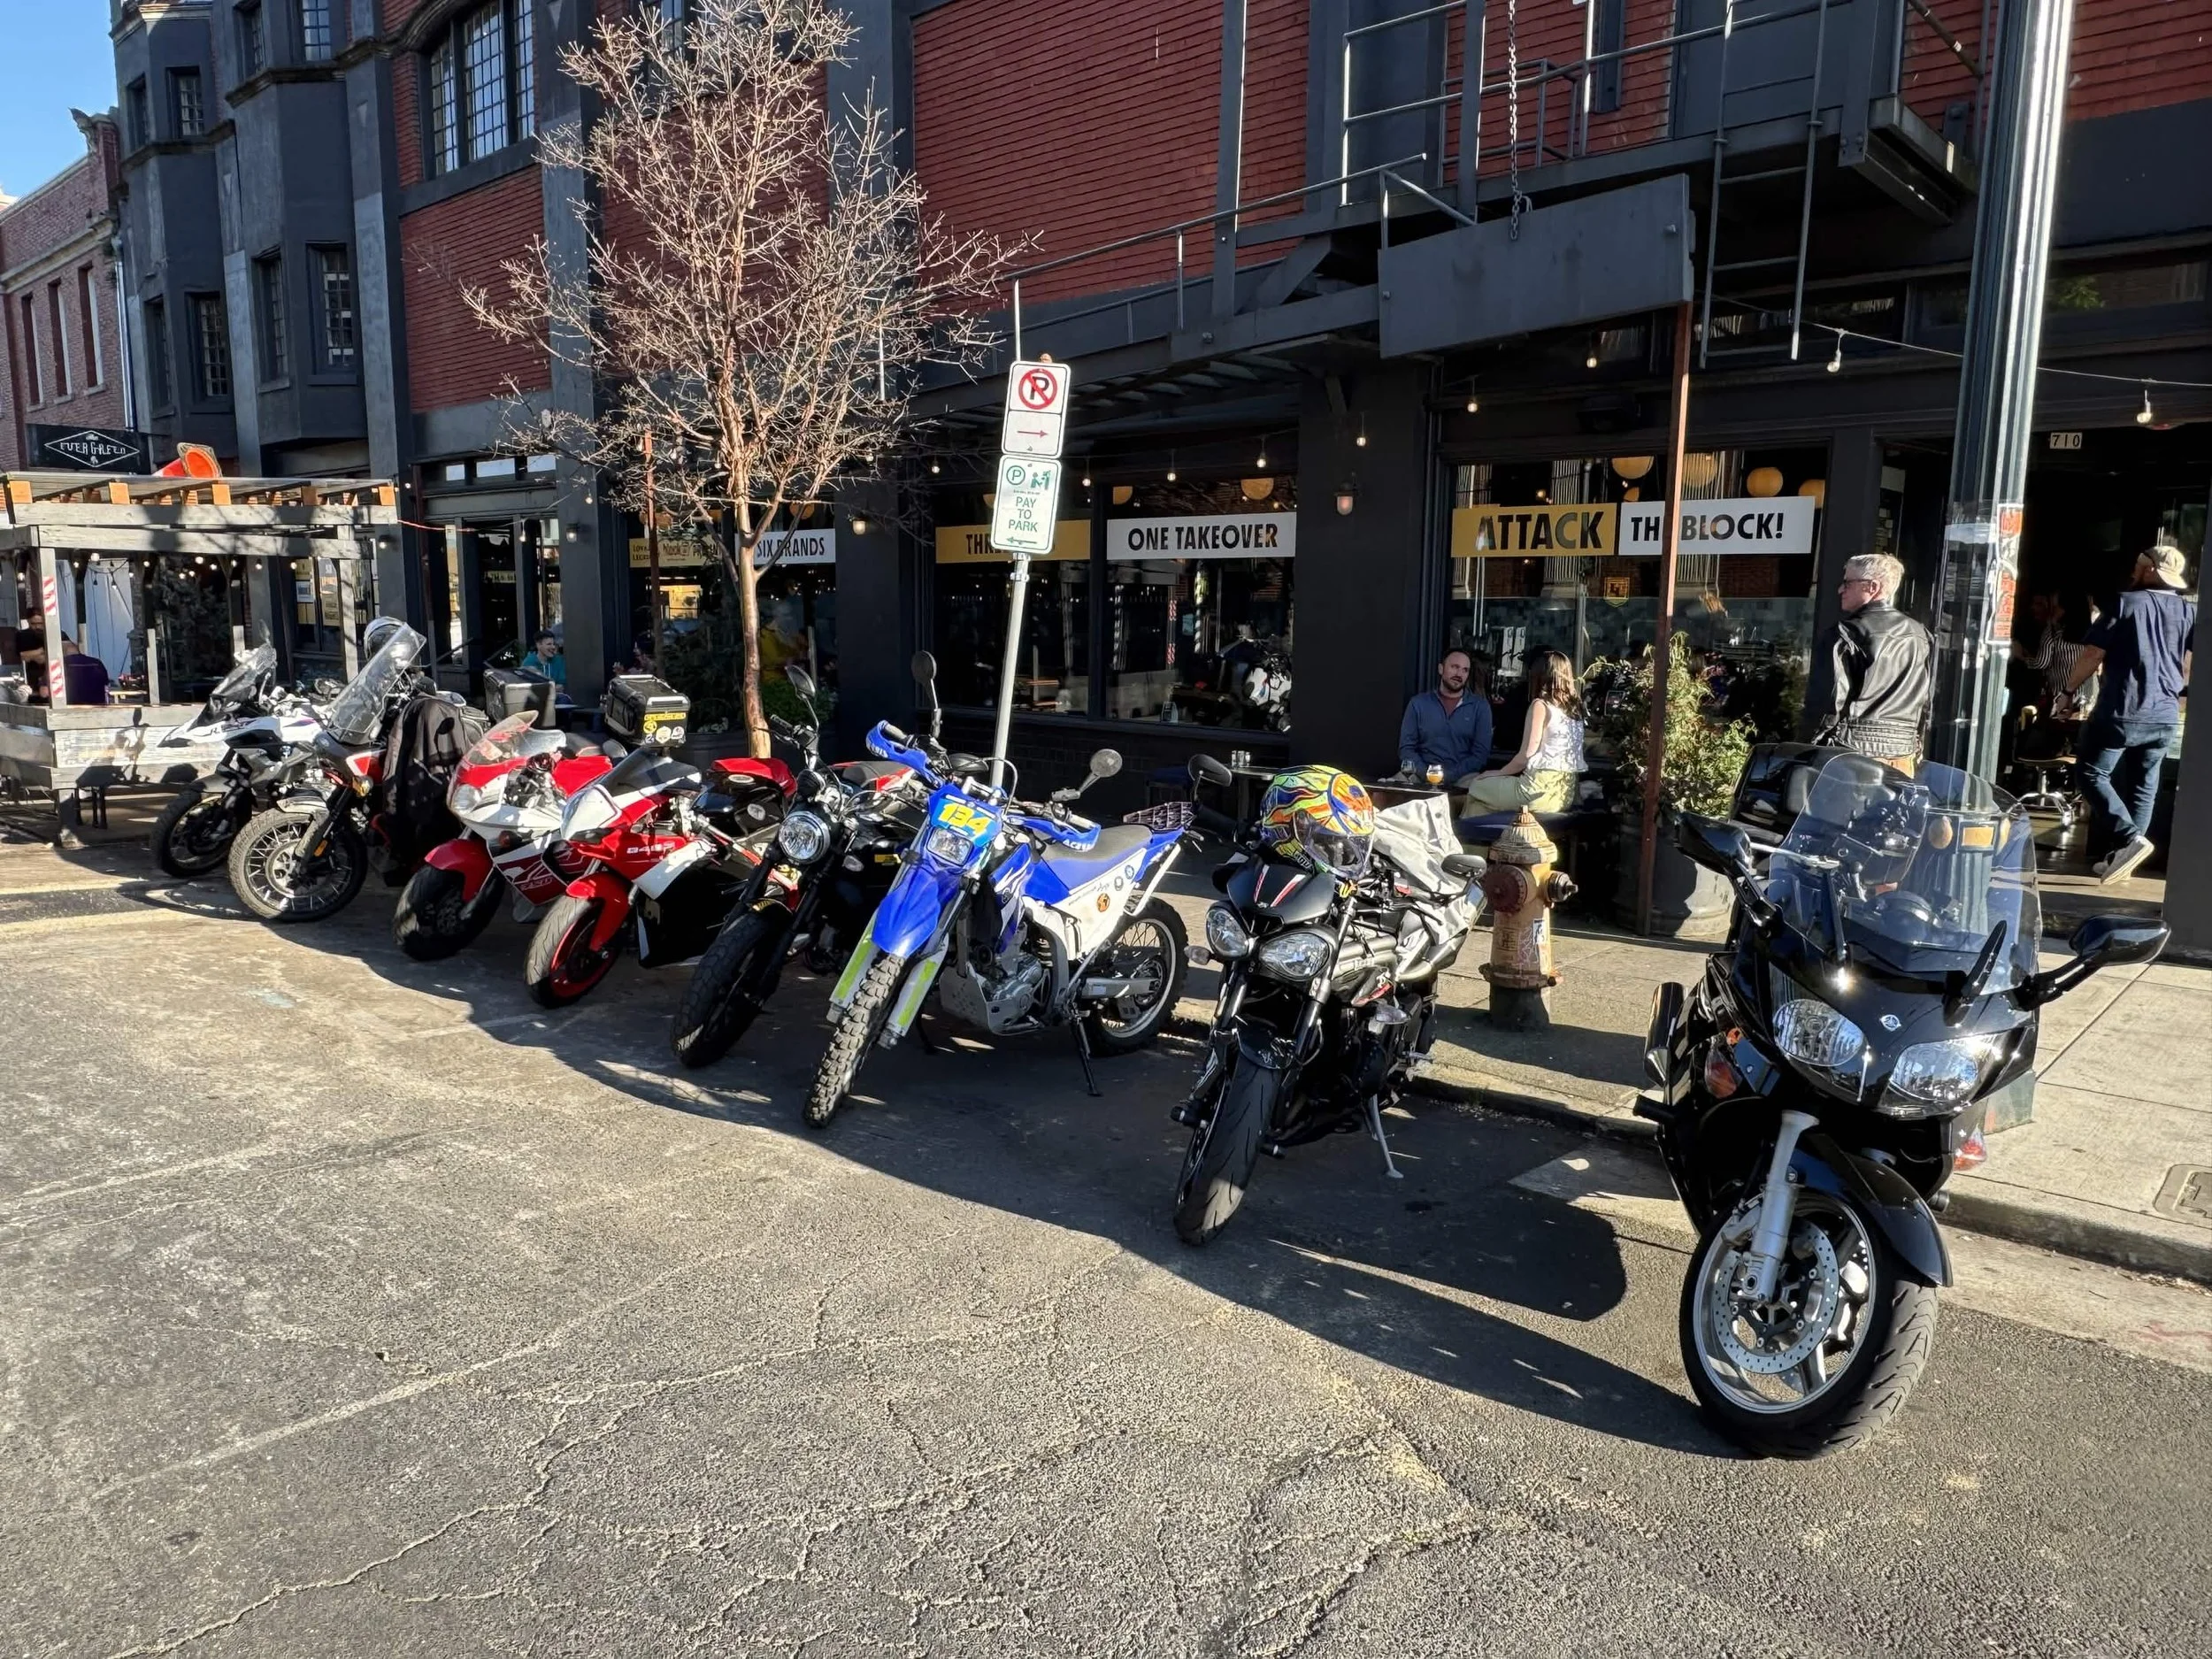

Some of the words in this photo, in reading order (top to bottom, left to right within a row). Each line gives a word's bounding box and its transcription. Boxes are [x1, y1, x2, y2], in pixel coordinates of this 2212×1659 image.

[2052, 434, 2080, 448] 710
[1016, 496, 1037, 508] PAY
[1018, 509, 1033, 519] TO
[1009, 519, 1038, 533] PARK
[1475, 511, 1604, 551] ATTACK
[1631, 516, 1661, 541] TH
[1681, 512, 1784, 541] BLOCK!
[1128, 527, 1169, 550] ONE
[1175, 523, 1278, 549] TAKEOVER
[757, 539, 773, 557] SIX
[938, 802, 992, 836] 134
